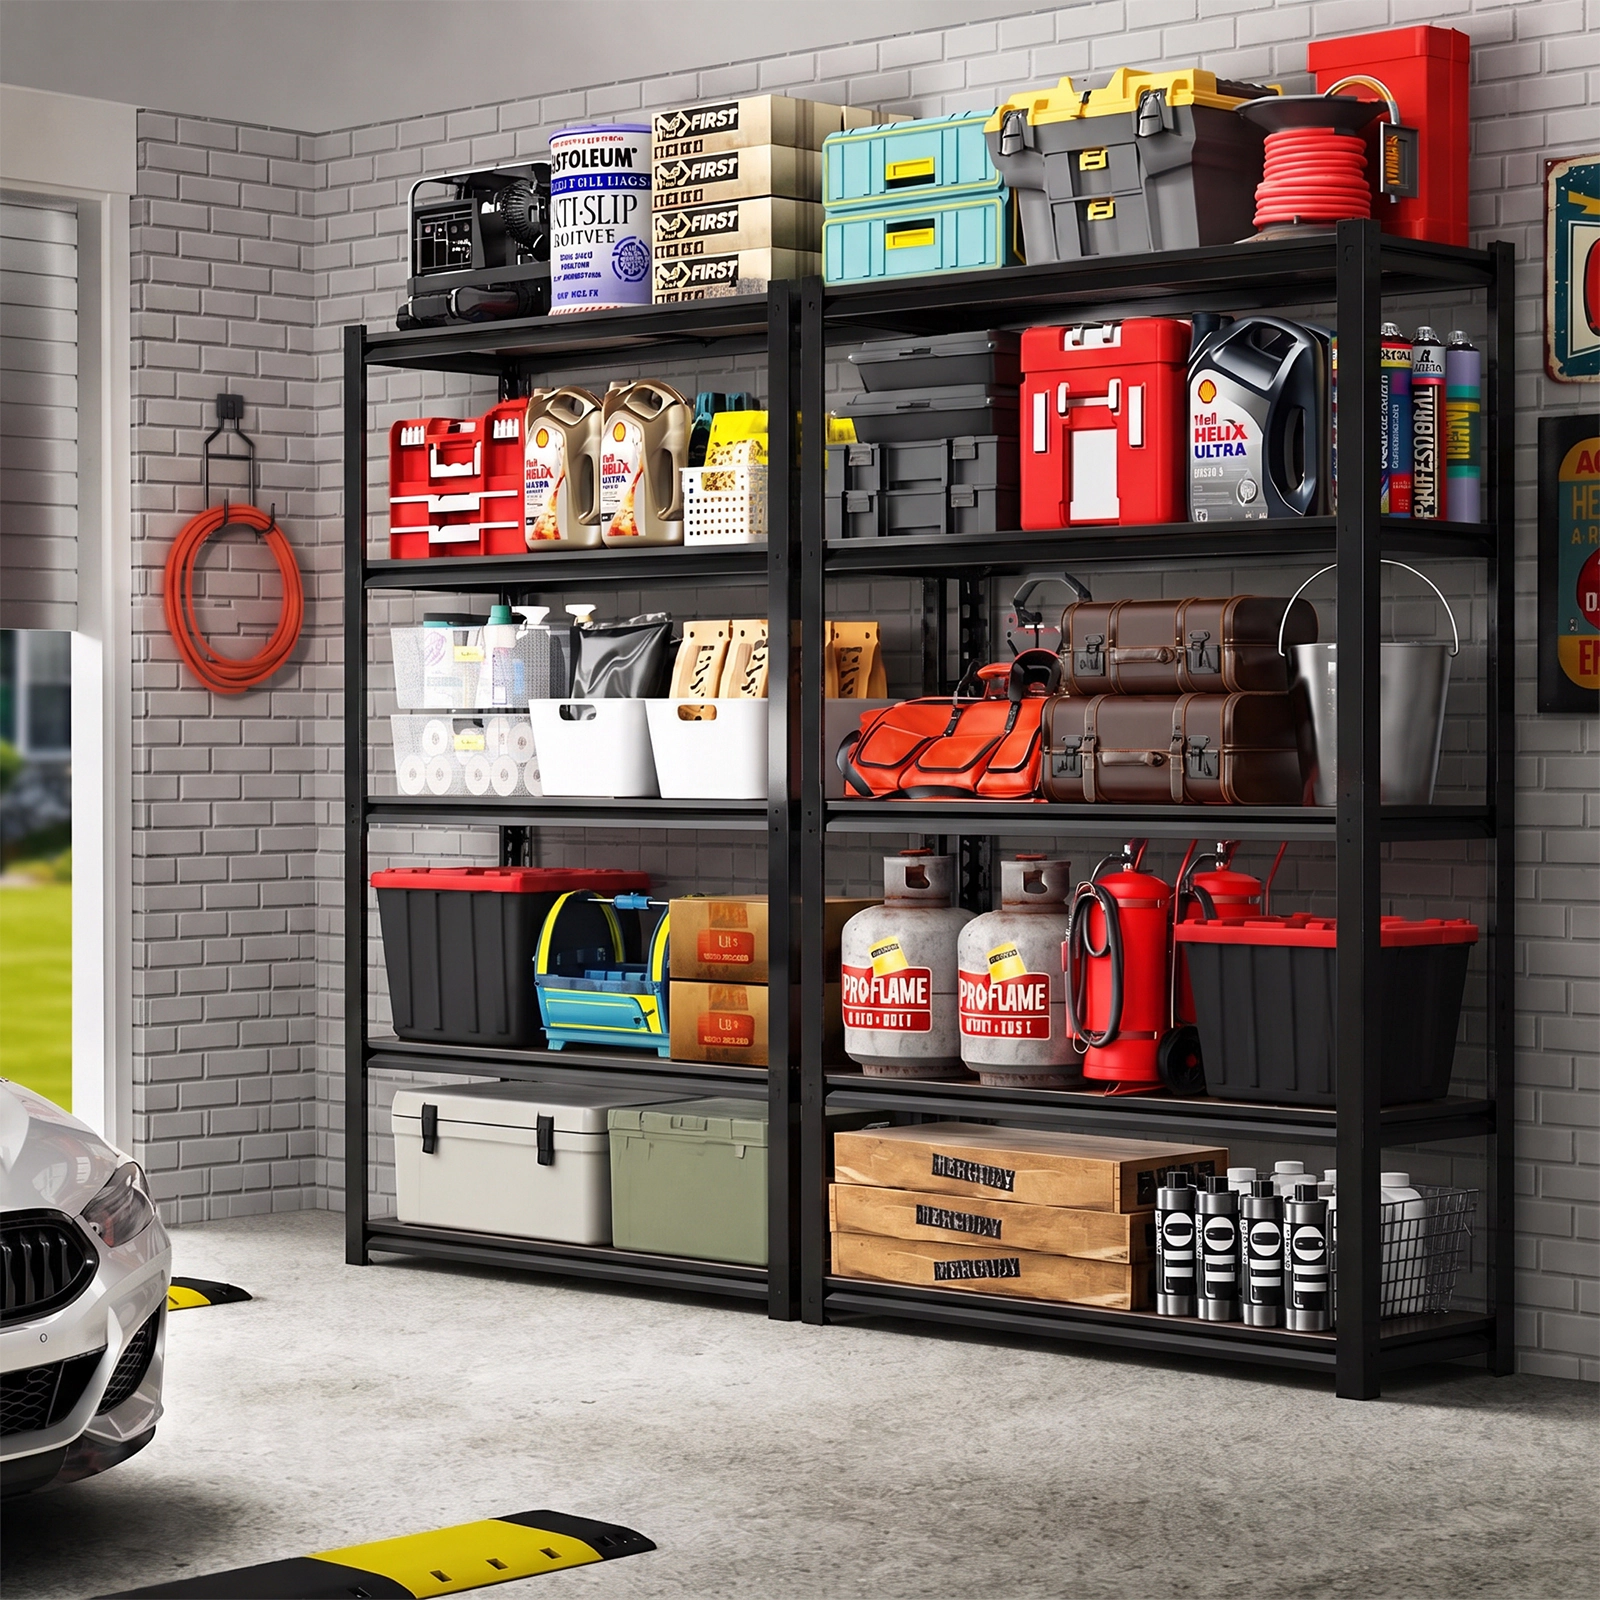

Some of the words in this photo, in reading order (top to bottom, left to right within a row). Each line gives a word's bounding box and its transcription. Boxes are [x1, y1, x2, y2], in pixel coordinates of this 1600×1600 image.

[691, 108, 738, 131] FIRST
[691, 157, 738, 181] FIRST
[691, 210, 738, 233] FIRST
[691, 260, 738, 281] FIRST
[1194, 424, 1248, 443] HELIX
[1194, 442, 1247, 459] ULTRA
[842, 973, 928, 1005] PROFLAME
[959, 978, 1047, 1012] PROFLAME
